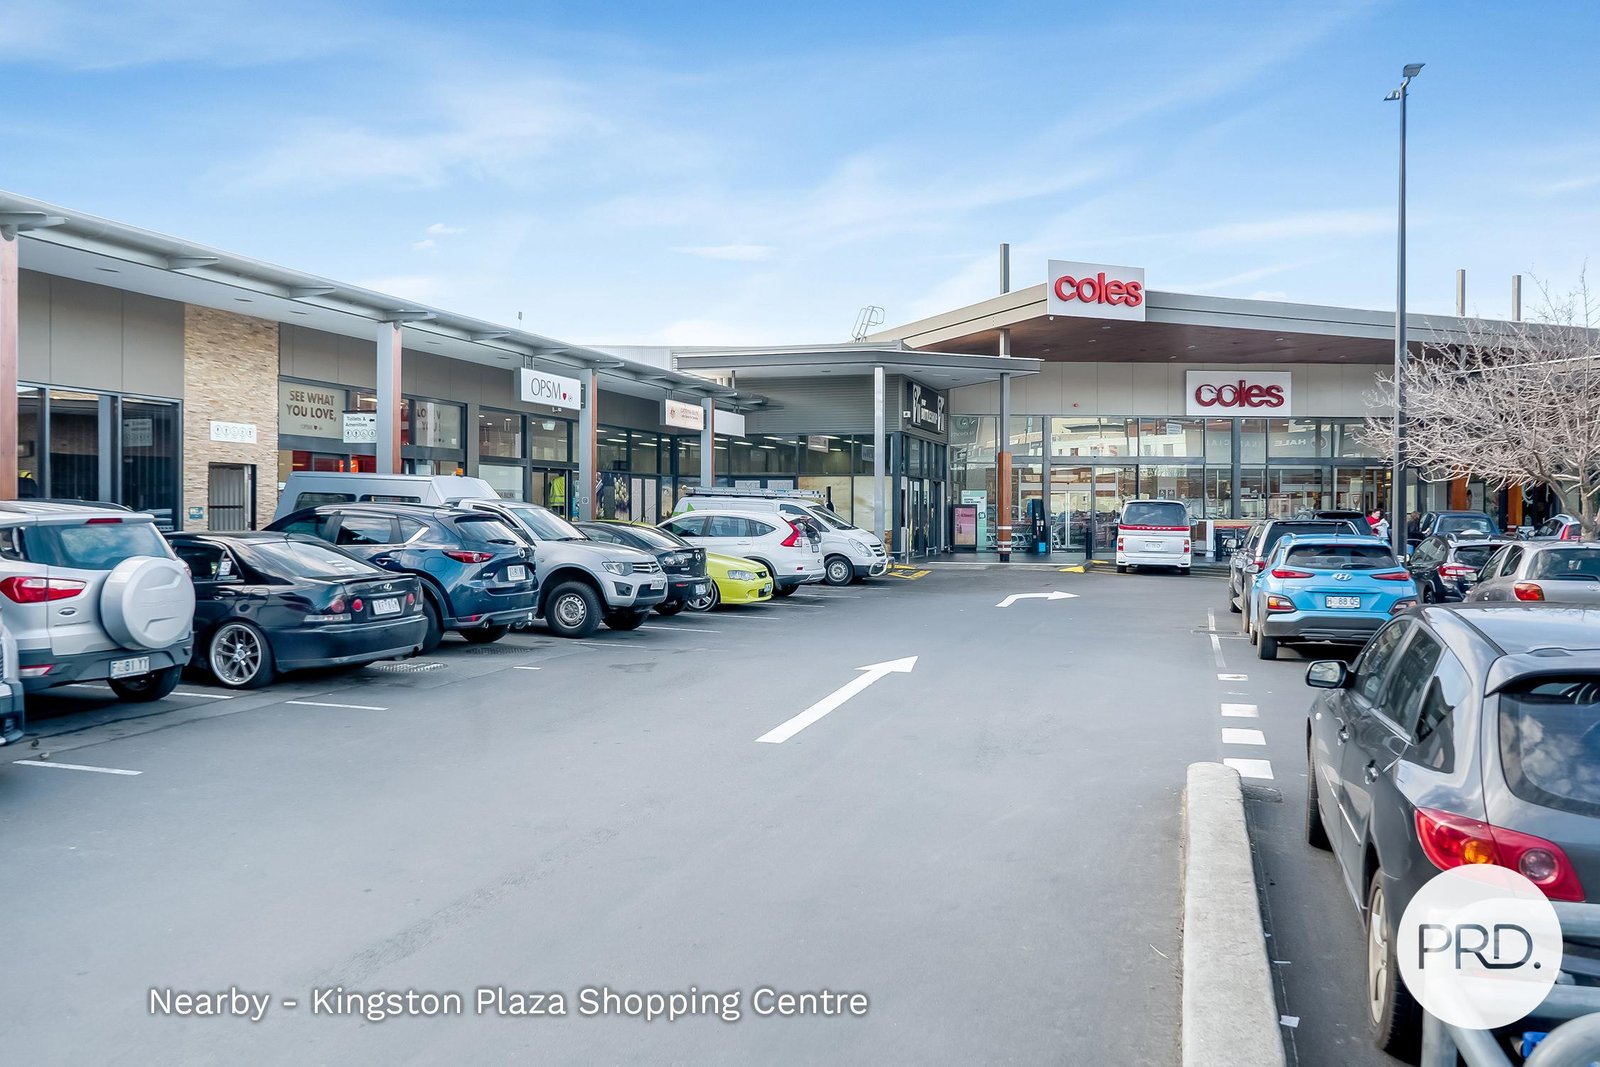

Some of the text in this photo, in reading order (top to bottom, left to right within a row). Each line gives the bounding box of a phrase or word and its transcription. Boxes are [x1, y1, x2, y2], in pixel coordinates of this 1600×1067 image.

[1055, 272, 1143, 307] coles
[290, 390, 335, 406] SEE WHAT
[531, 377, 561, 400] OPSM
[1195, 380, 1285, 407] coles
[287, 404, 336, 422] YOU LOVE,
